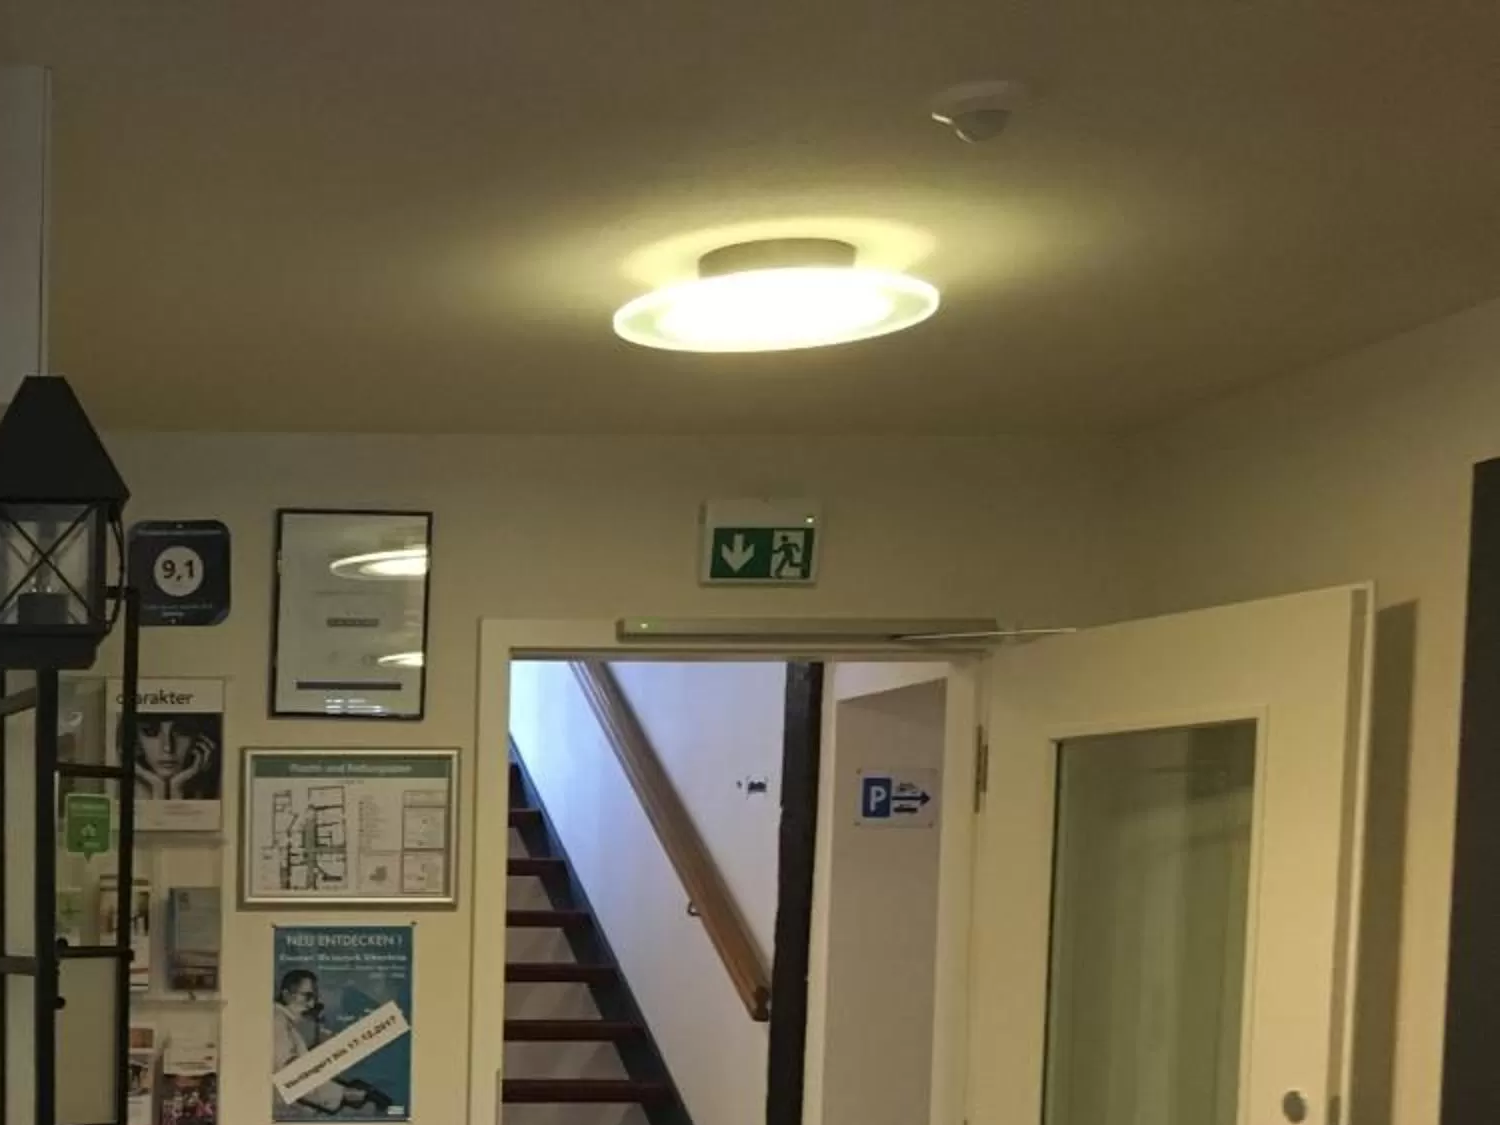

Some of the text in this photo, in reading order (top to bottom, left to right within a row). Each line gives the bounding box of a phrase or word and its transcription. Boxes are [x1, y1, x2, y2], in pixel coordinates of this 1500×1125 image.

[161, 559, 194, 582] 9,1
[870, 785, 887, 813] P
[286, 934, 315, 947] NEU
[317, 934, 395, 947] ENTDECKEN
